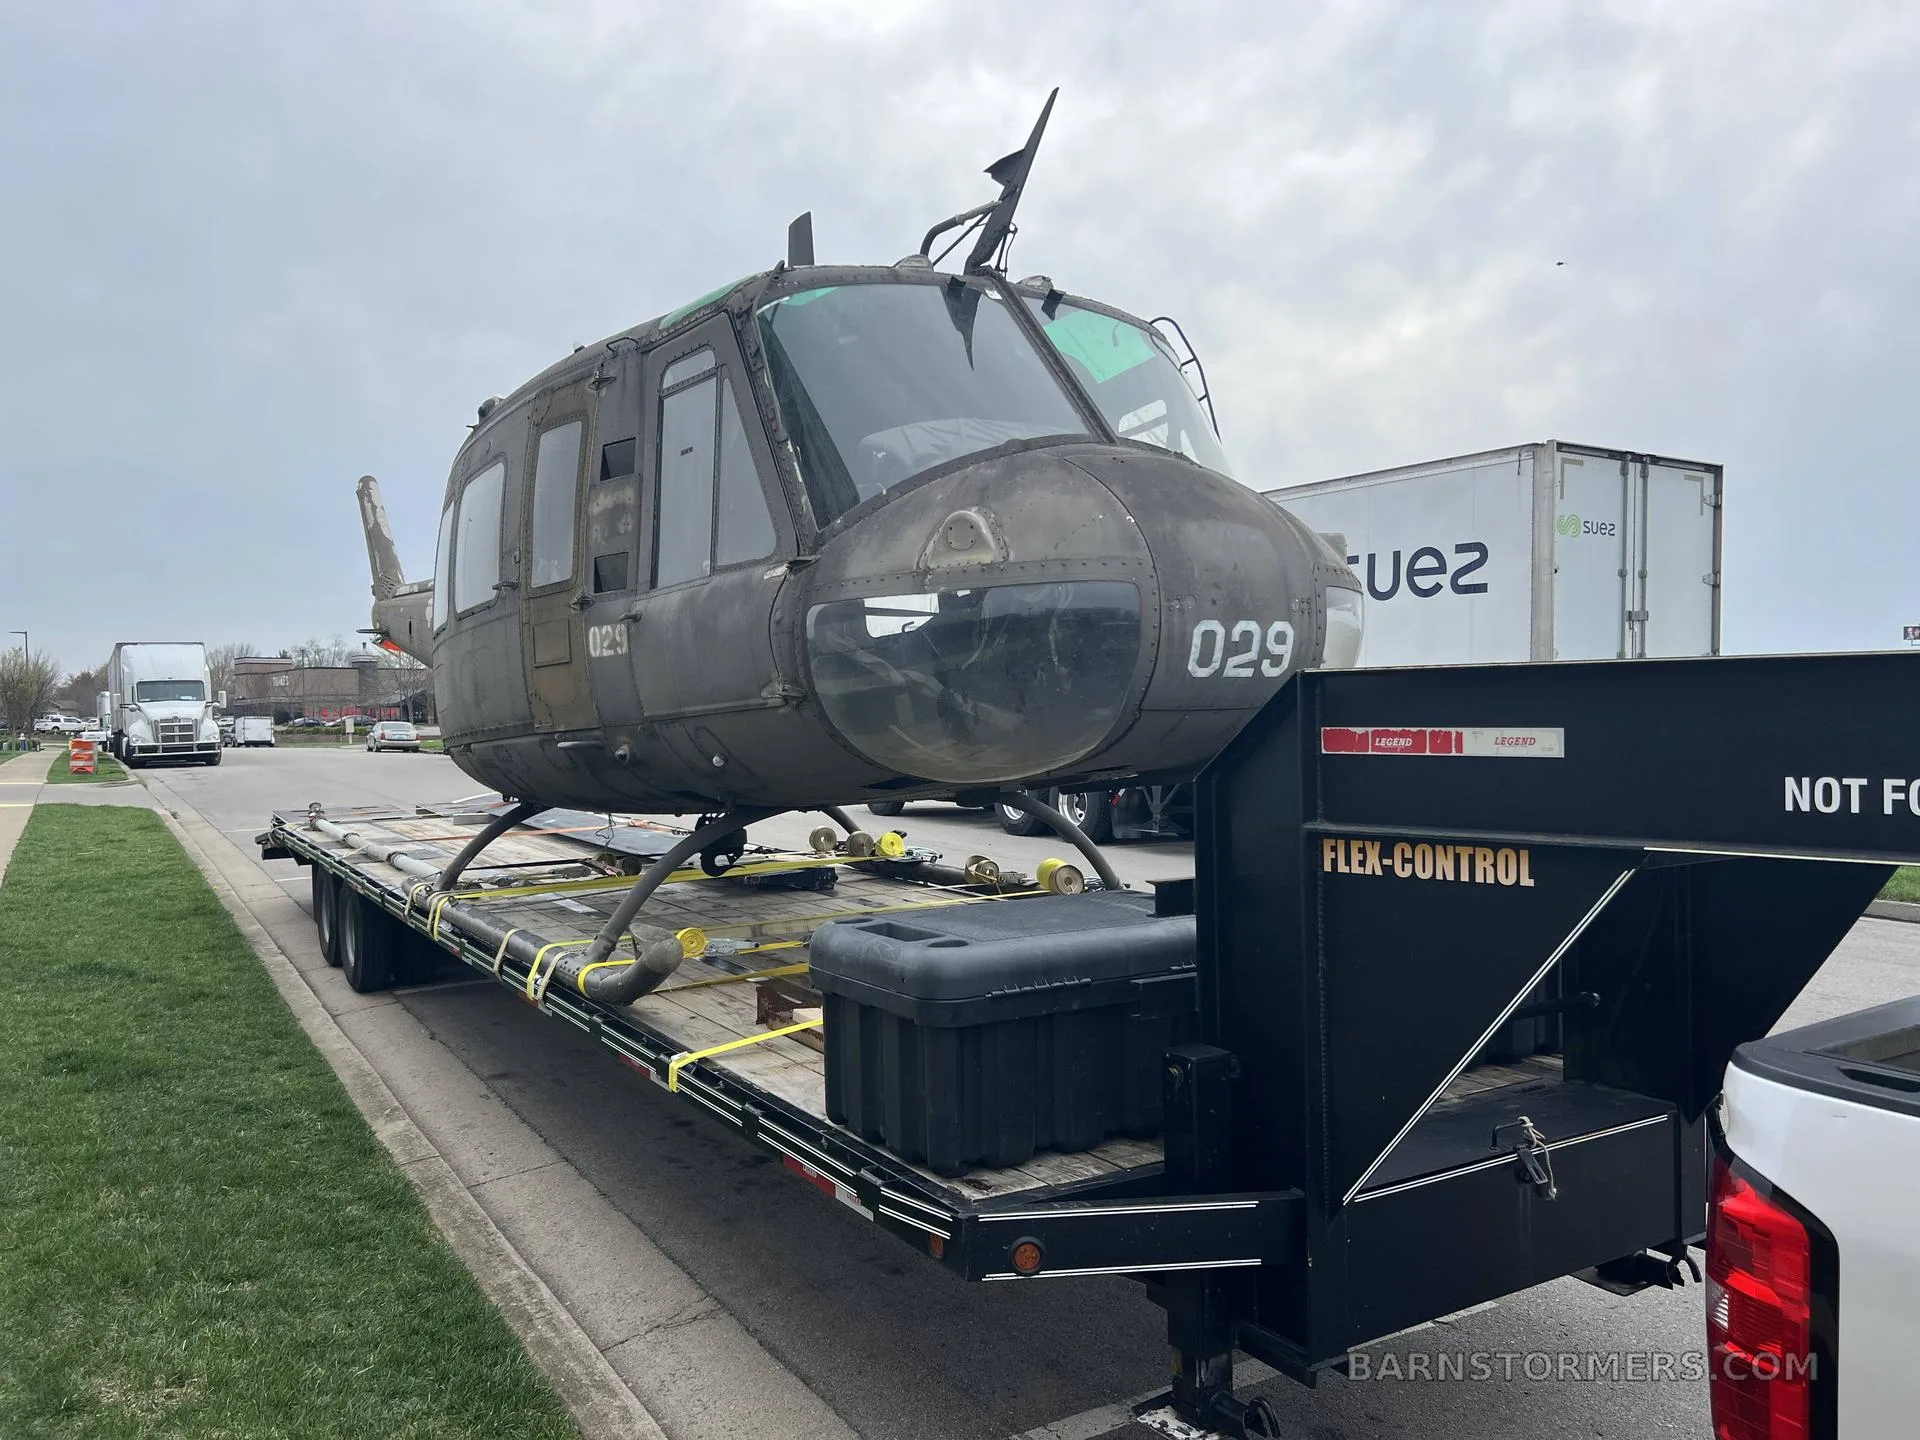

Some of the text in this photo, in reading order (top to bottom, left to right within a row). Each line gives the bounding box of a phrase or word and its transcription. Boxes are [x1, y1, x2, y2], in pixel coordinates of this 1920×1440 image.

[589, 623, 628, 657] 029
[1187, 619, 1295, 678] 029
[1374, 737, 1413, 747] LEGEND
[1494, 736, 1537, 746] LEGEND
[1784, 776, 1868, 814] NOT
[1322, 838, 1535, 887] FLEX-CONTROL
